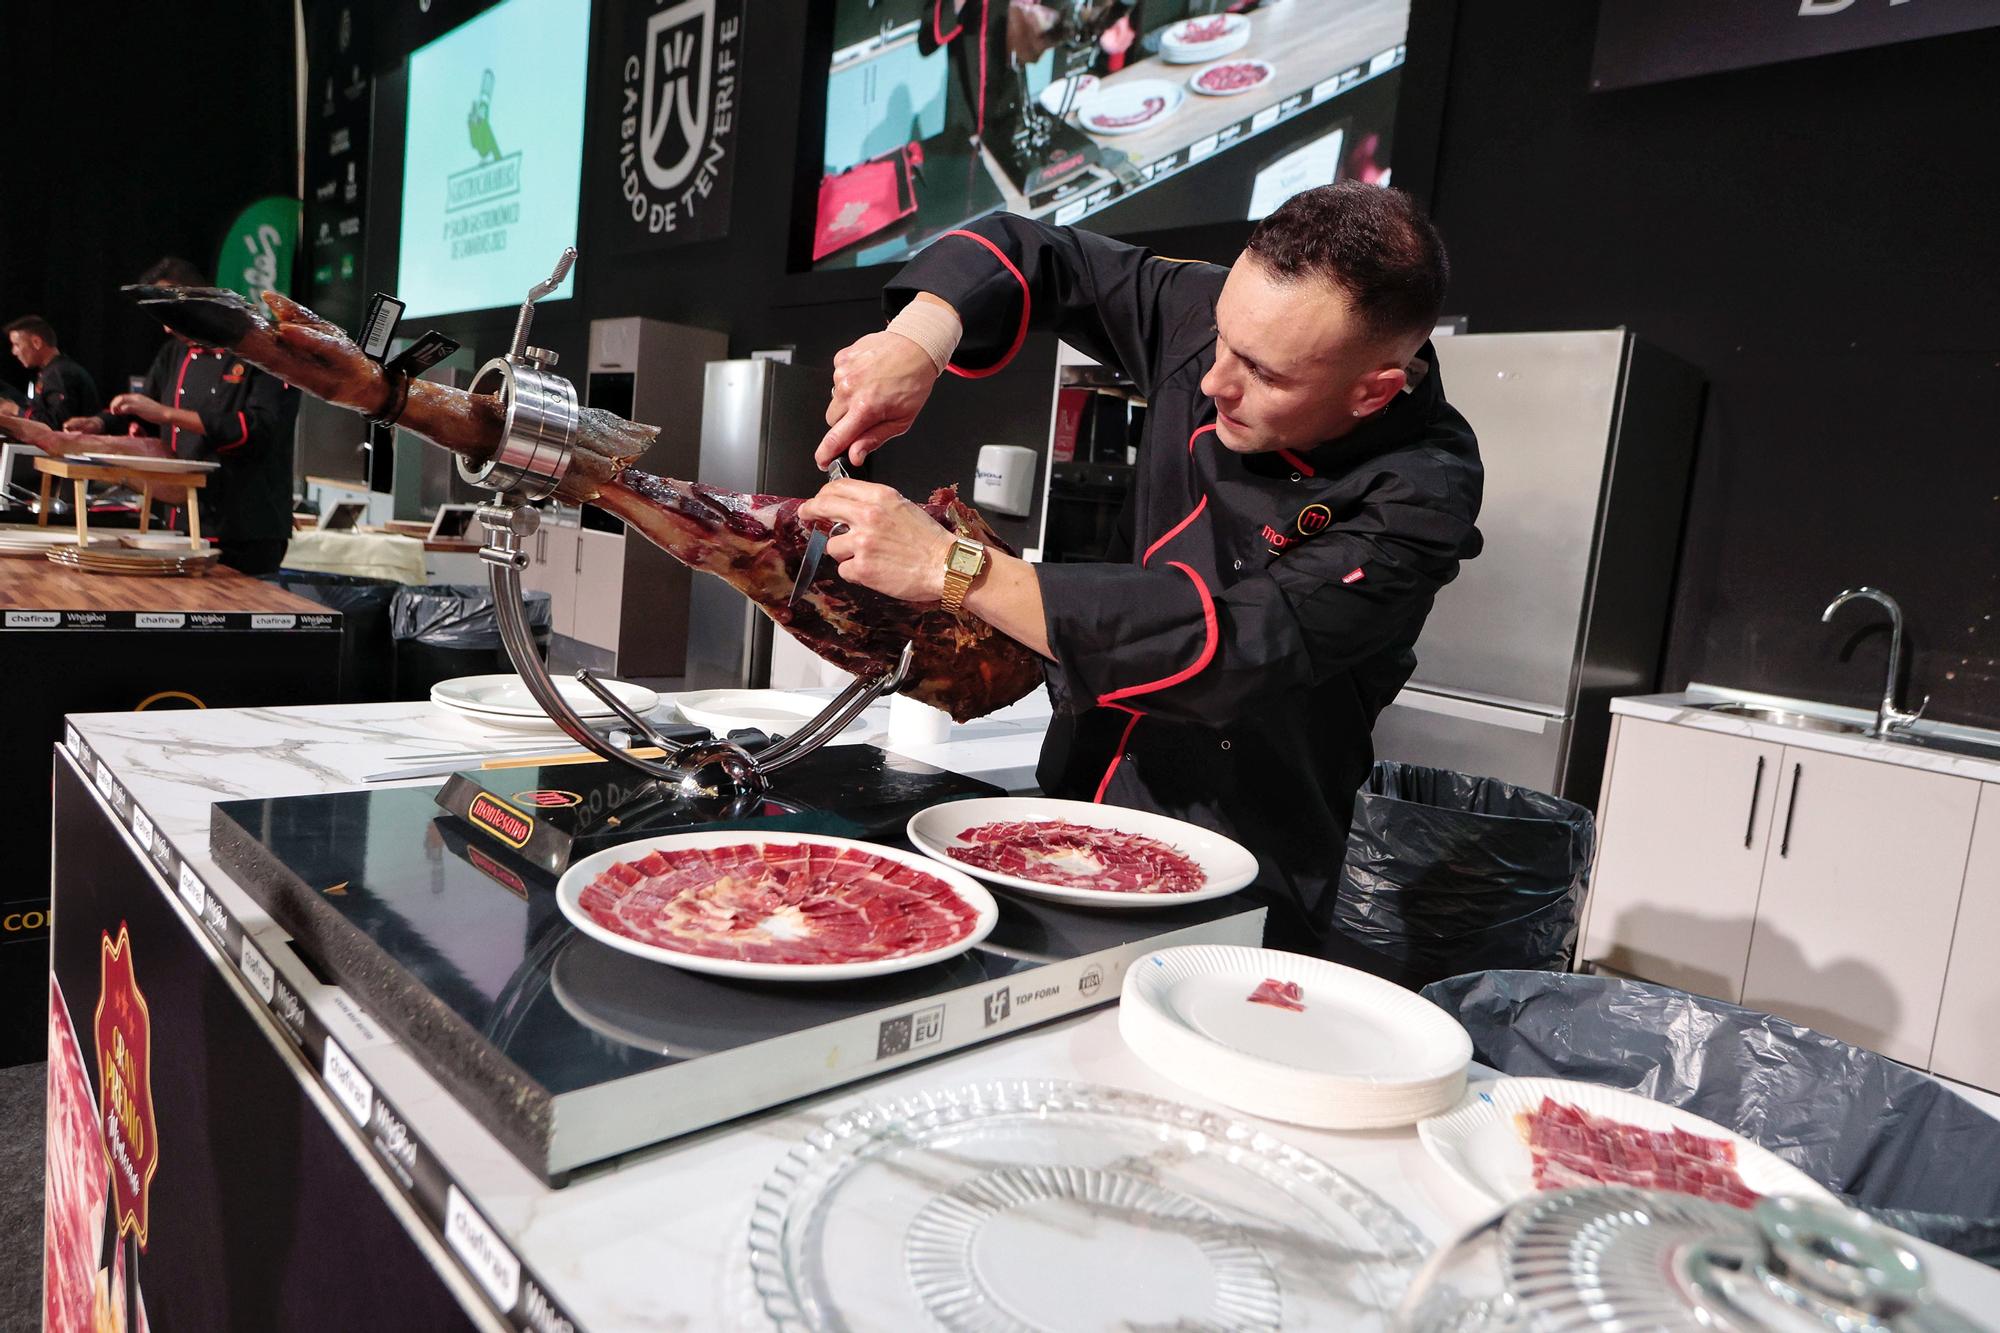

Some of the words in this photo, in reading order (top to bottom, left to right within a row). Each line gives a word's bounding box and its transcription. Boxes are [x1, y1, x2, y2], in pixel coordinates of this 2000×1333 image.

[619, 54, 648, 223] CABILDO
[648, 201, 678, 233] DE
[681, 15, 740, 219] TENERIFE
[11, 614, 55, 623] chafiras
[67, 612, 107, 624] Whirlpool
[141, 614, 181, 624] chafiras
[190, 614, 226, 626] Whirlpool
[256, 615, 292, 625] chafiras
[300, 614, 333, 626] Whirlpool
[473, 799, 529, 841] montesano
[182, 873, 203, 905] chafiras
[245, 951, 271, 991] chafiras
[1016, 994, 1033, 1006] TOP
[1035, 985, 1060, 1001] FORM
[915, 1023, 939, 1043] EU
[112, 1025, 137, 1097] GRAN
[330, 1056, 367, 1110] chafiras
[106, 1048, 144, 1161] PREMIO
